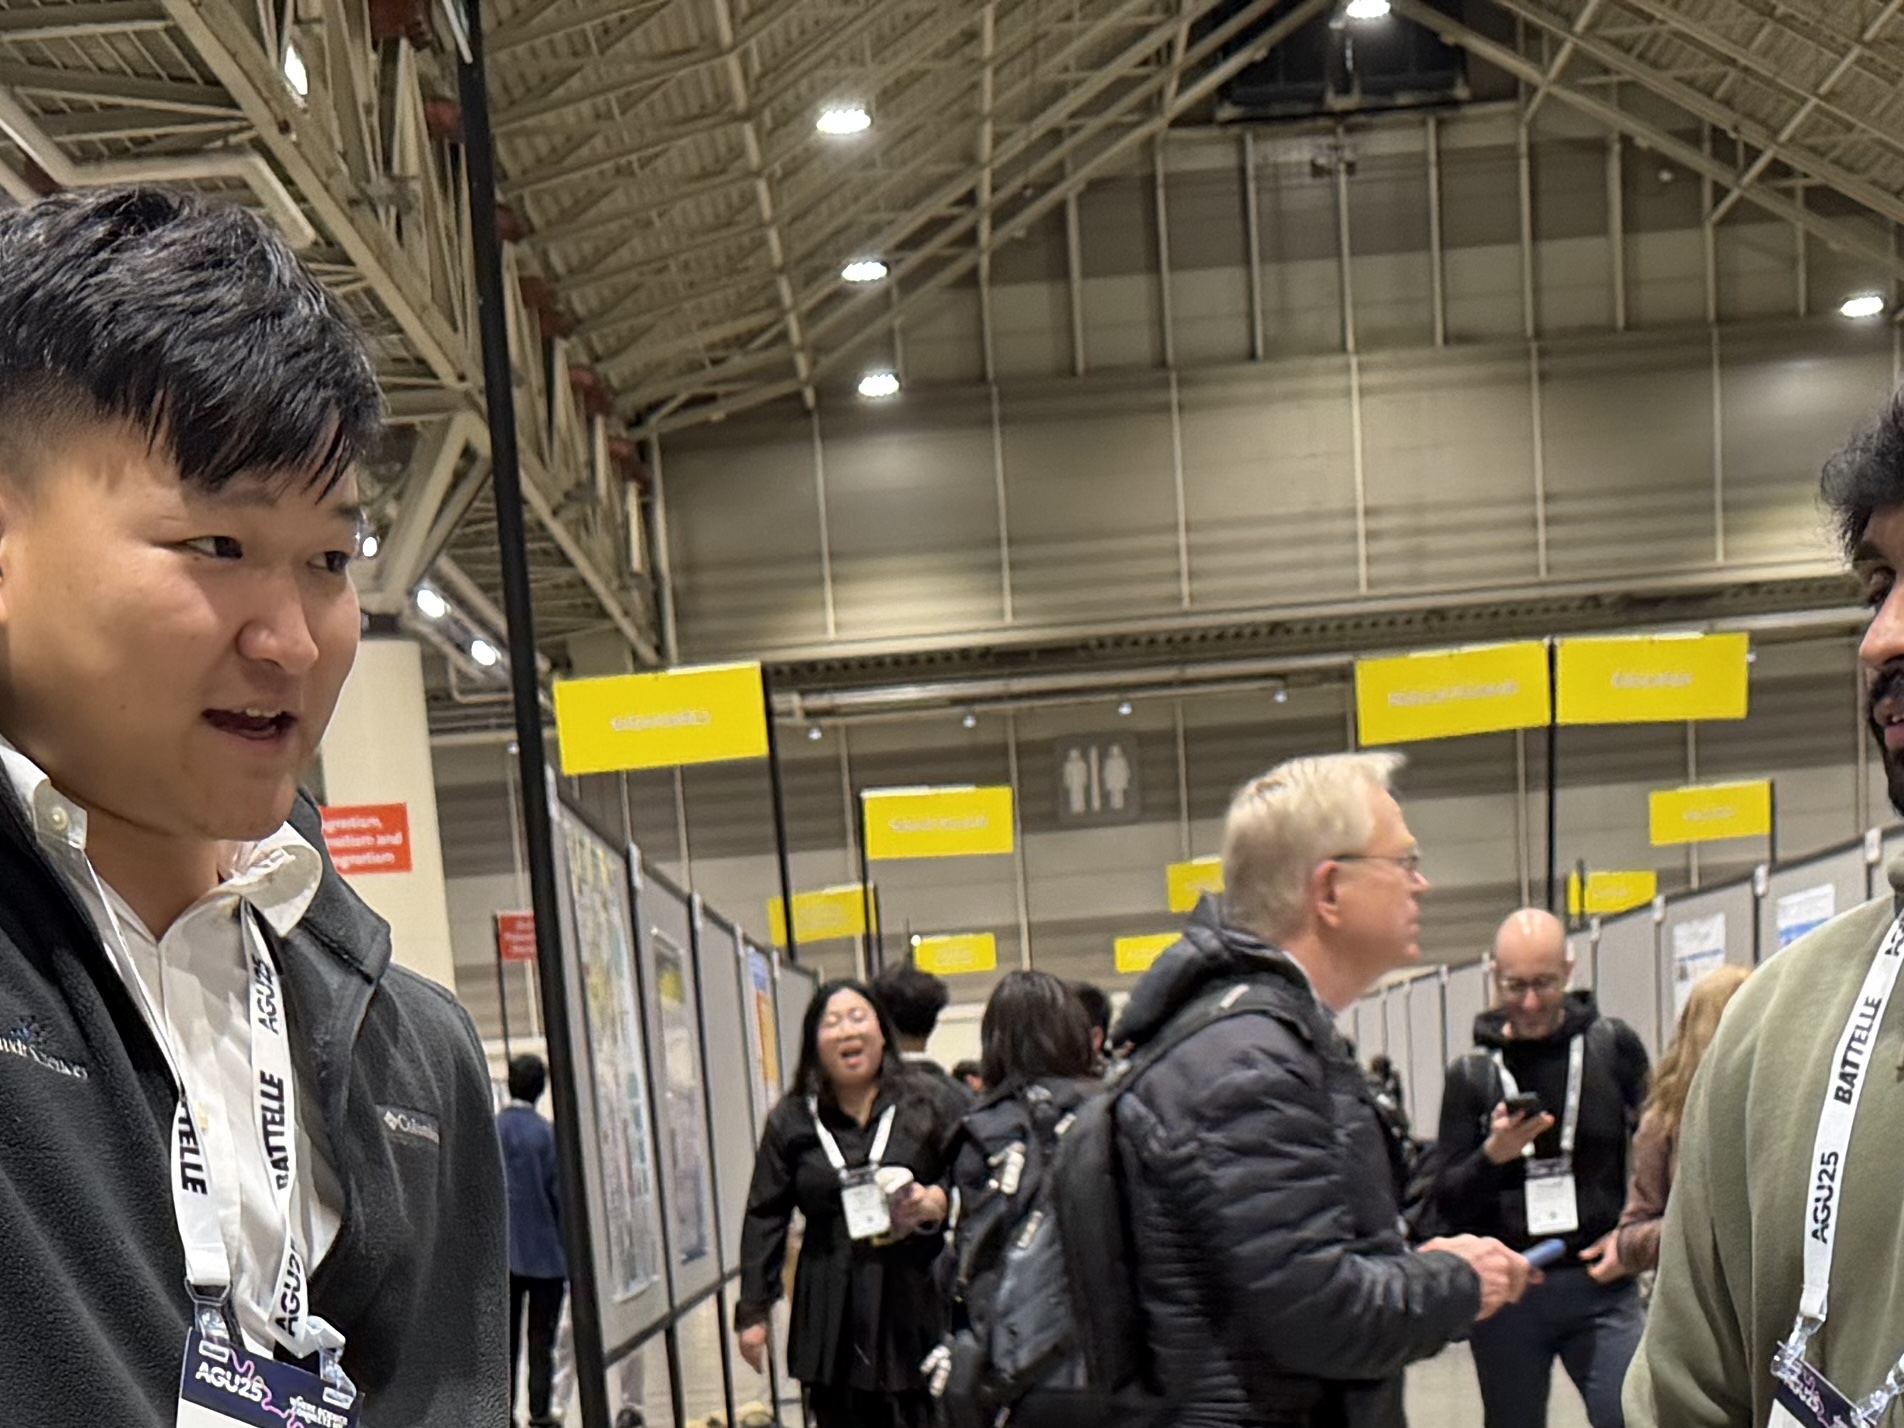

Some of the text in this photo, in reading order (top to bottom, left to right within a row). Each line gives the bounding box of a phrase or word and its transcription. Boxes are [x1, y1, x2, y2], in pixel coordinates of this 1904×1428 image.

[376, 831, 403, 845] and
[251, 953, 280, 1036] AGU25
[1833, 995, 1882, 1105] BATTELLE
[177, 1104, 208, 1195] TELLE
[259, 1069, 290, 1191] BATTELLE
[1811, 1151, 1839, 1244] AGU25
[195, 1361, 265, 1402] AGU25
